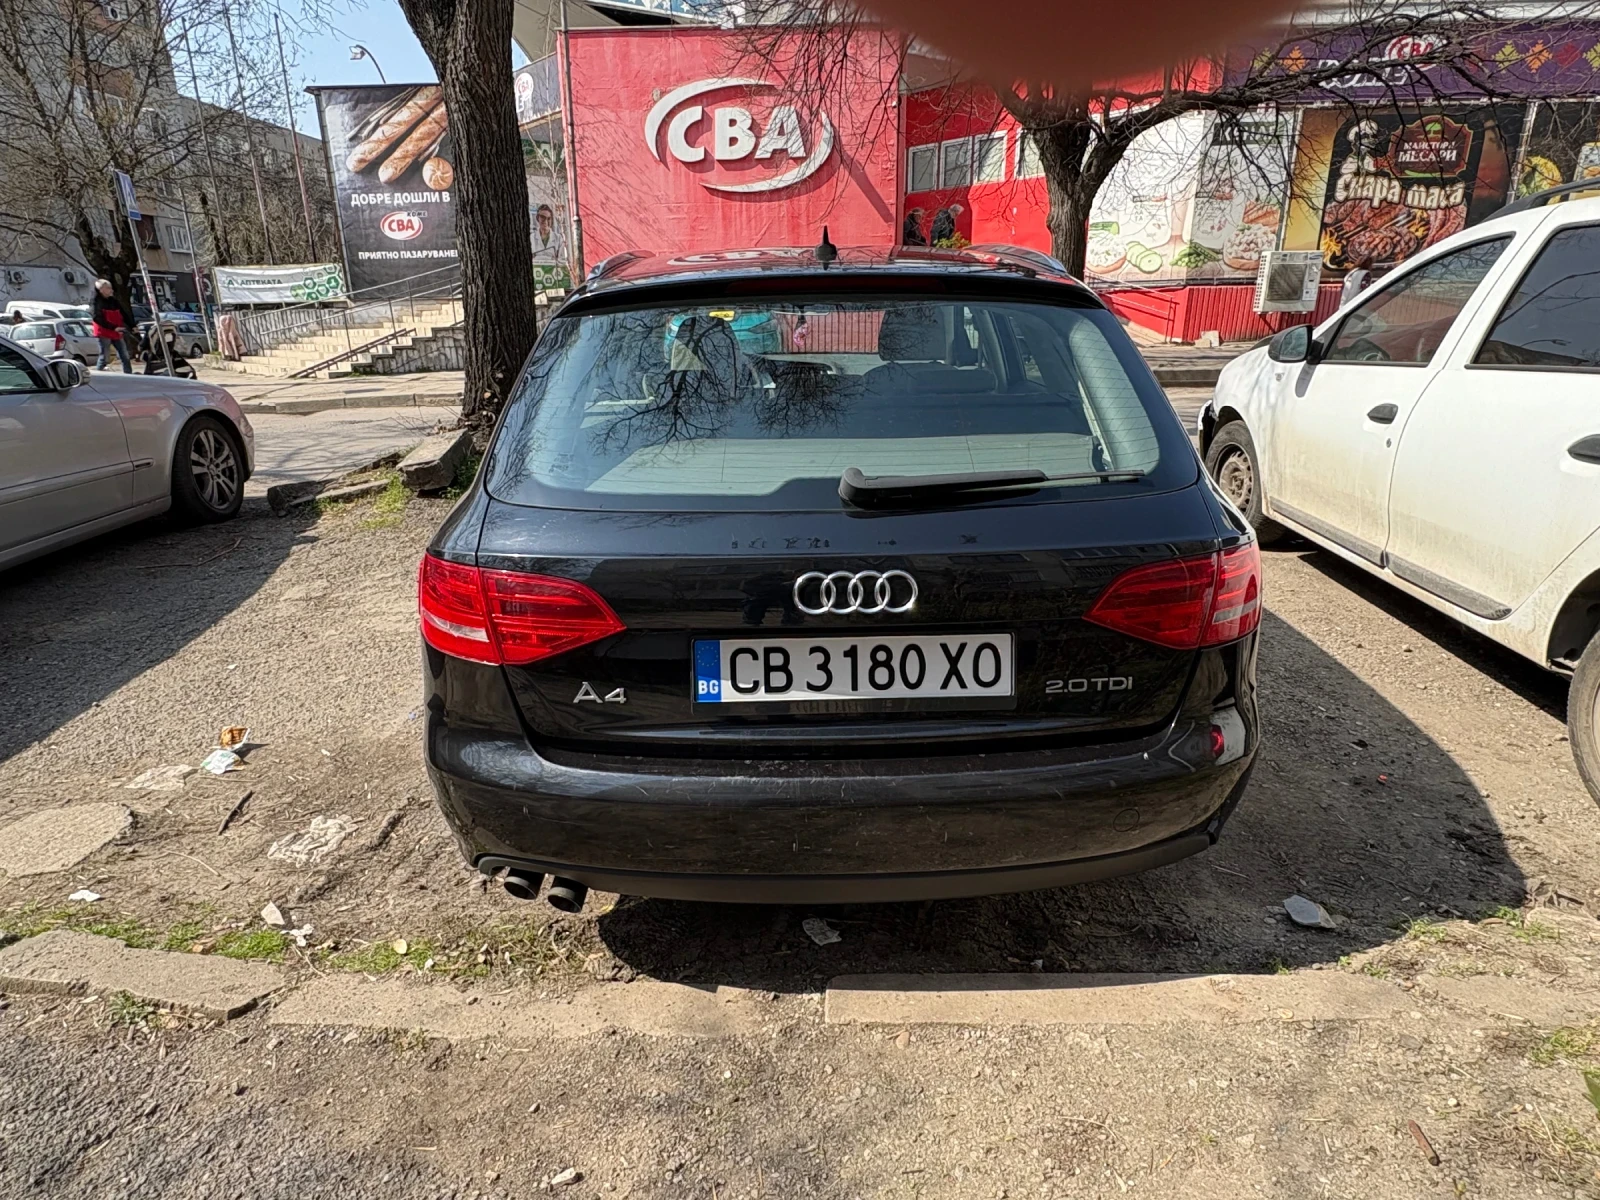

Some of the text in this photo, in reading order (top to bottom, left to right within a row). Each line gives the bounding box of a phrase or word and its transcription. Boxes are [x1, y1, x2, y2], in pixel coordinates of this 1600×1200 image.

[667, 105, 806, 163] CBA
[1398, 151, 1457, 162] МЕСАРИ
[351, 191, 450, 207] ДОБРЕ ДОШЛИ В
[388, 219, 415, 232] CBA
[358, 251, 399, 260] ПРИЯТНО
[729, 642, 1002, 694] CB 3180 XO
[572, 681, 627, 704] A4
[698, 680, 719, 695] BG
